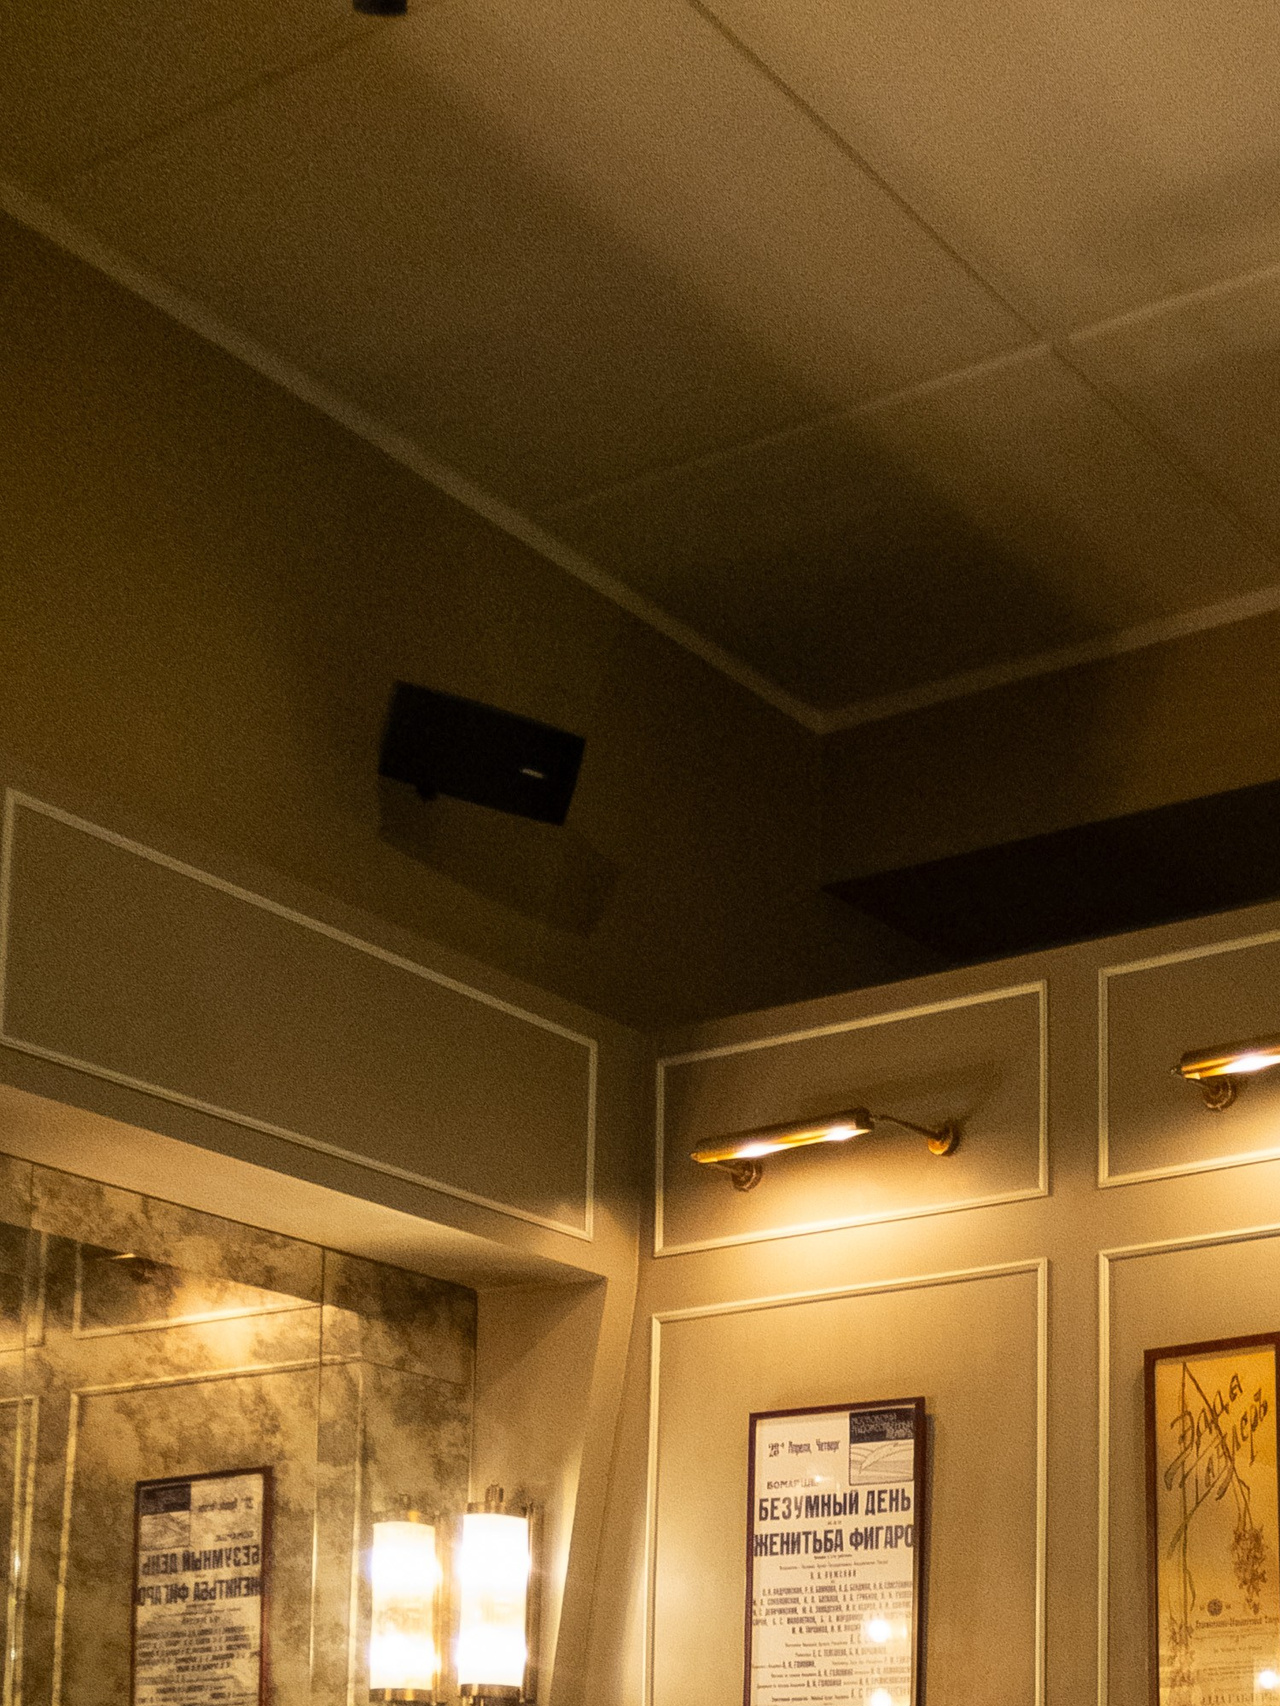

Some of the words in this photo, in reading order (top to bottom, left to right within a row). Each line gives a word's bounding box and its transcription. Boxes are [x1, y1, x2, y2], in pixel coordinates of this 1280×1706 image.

[759, 1489, 859, 1521] БЕЗУМНЫЙ
[865, 1488, 911, 1515] ДЕНЬ
[754, 1529, 844, 1556] ЖЕНИТЬБА
[849, 1524, 914, 1550] ФИГАРО
